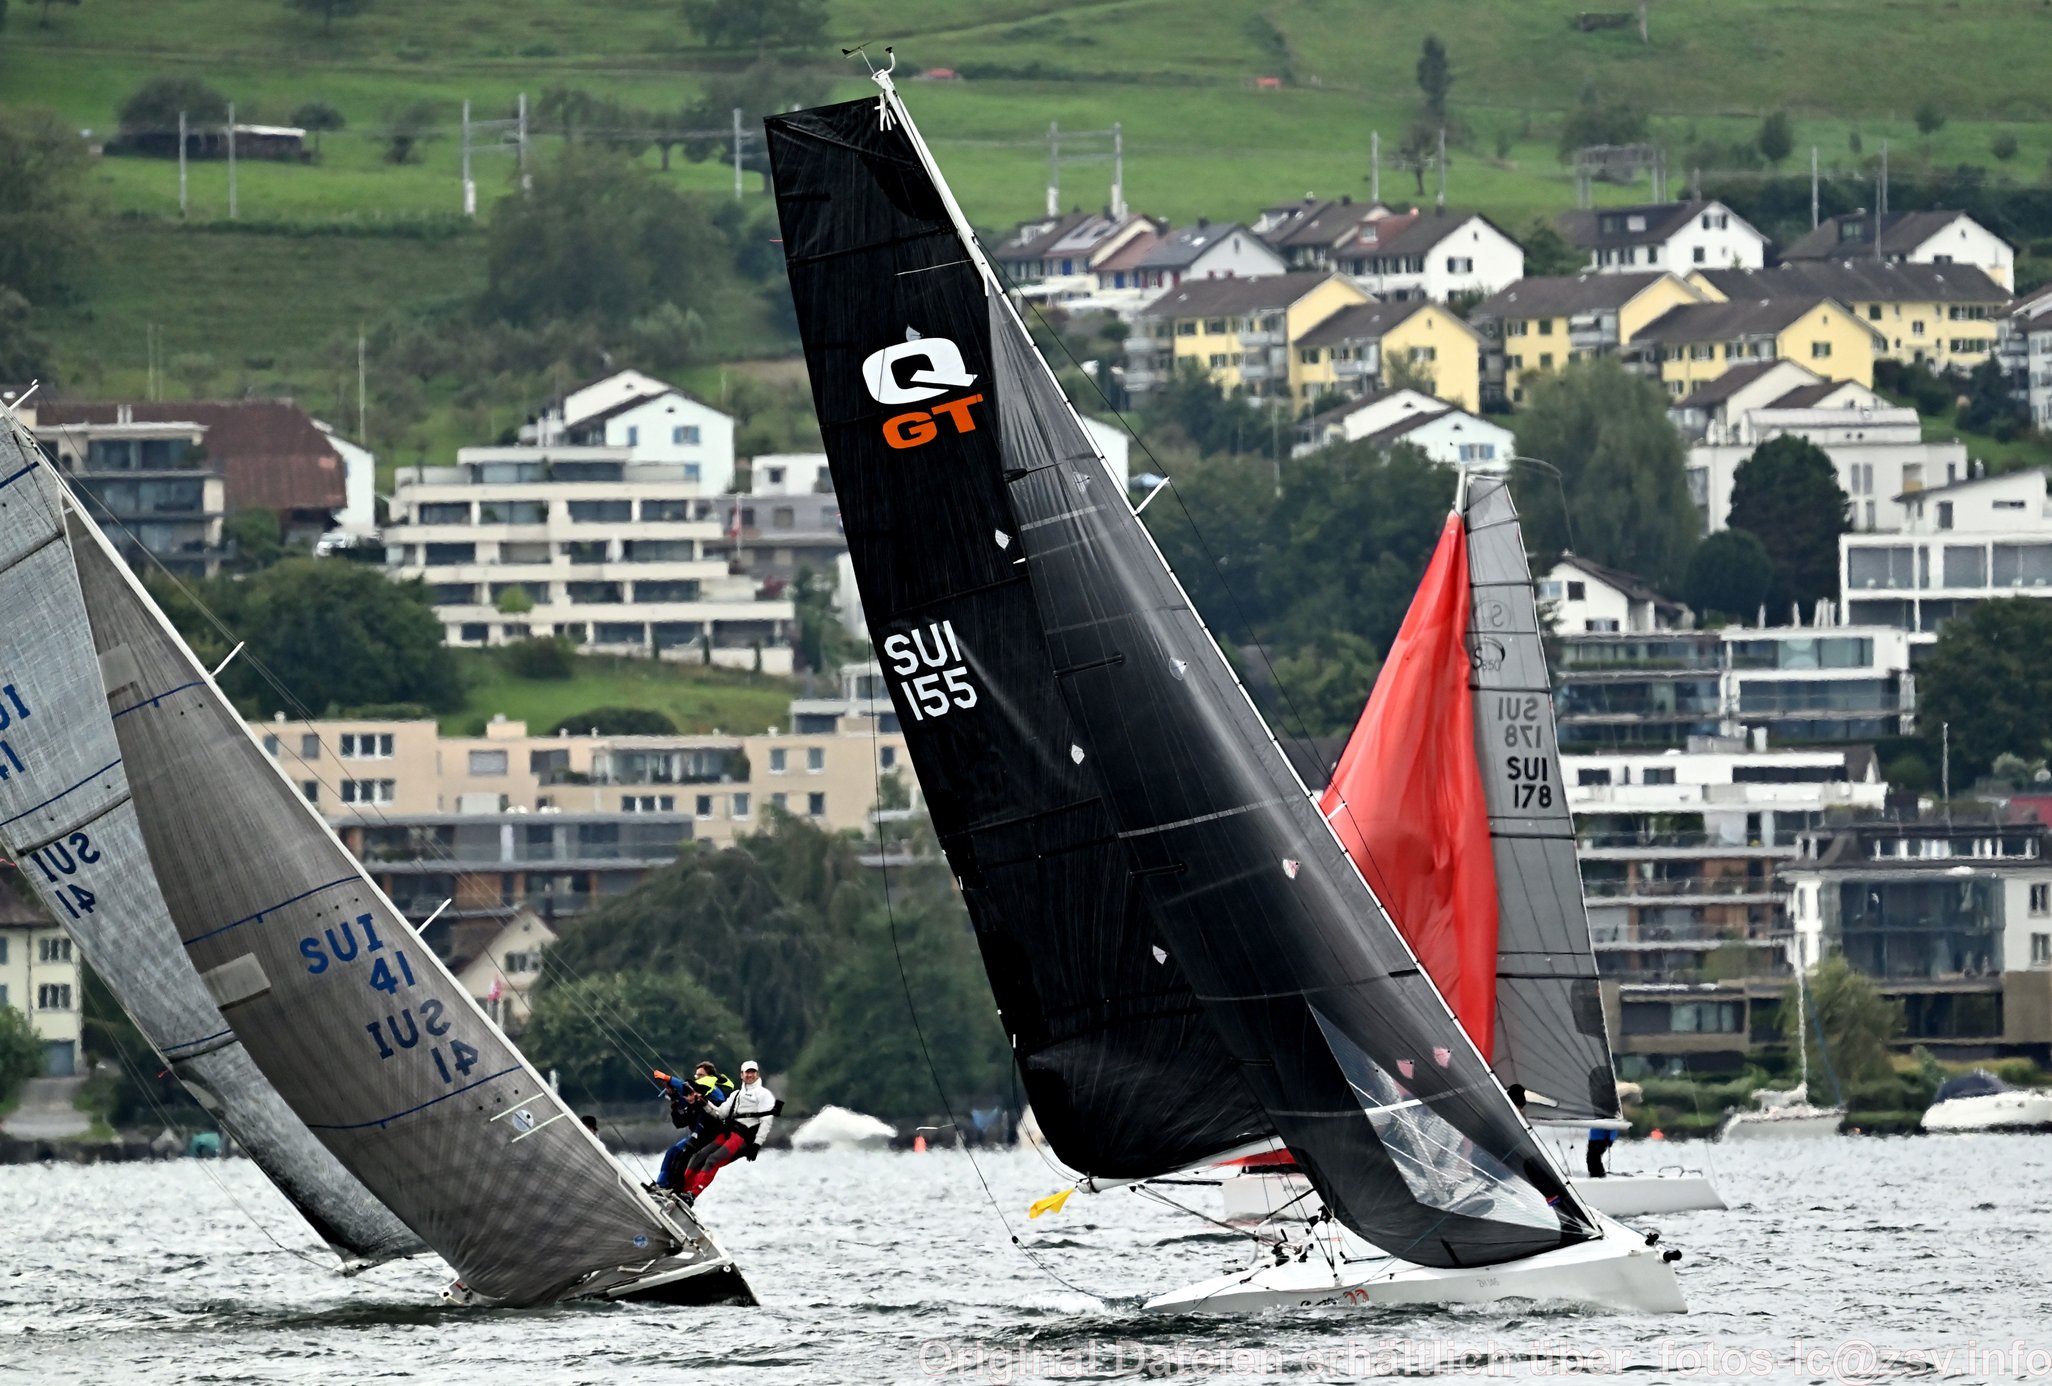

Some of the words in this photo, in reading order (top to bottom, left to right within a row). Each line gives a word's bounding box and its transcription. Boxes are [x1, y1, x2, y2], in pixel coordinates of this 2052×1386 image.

[862, 337, 978, 405] Q
[882, 393, 984, 449] GT
[884, 620, 962, 676] SUI
[901, 666, 978, 721] 155
[1507, 756, 1548, 782] SUI
[1513, 784, 1552, 809] 178
[299, 912, 384, 974] SUI
[369, 950, 416, 995] 41
